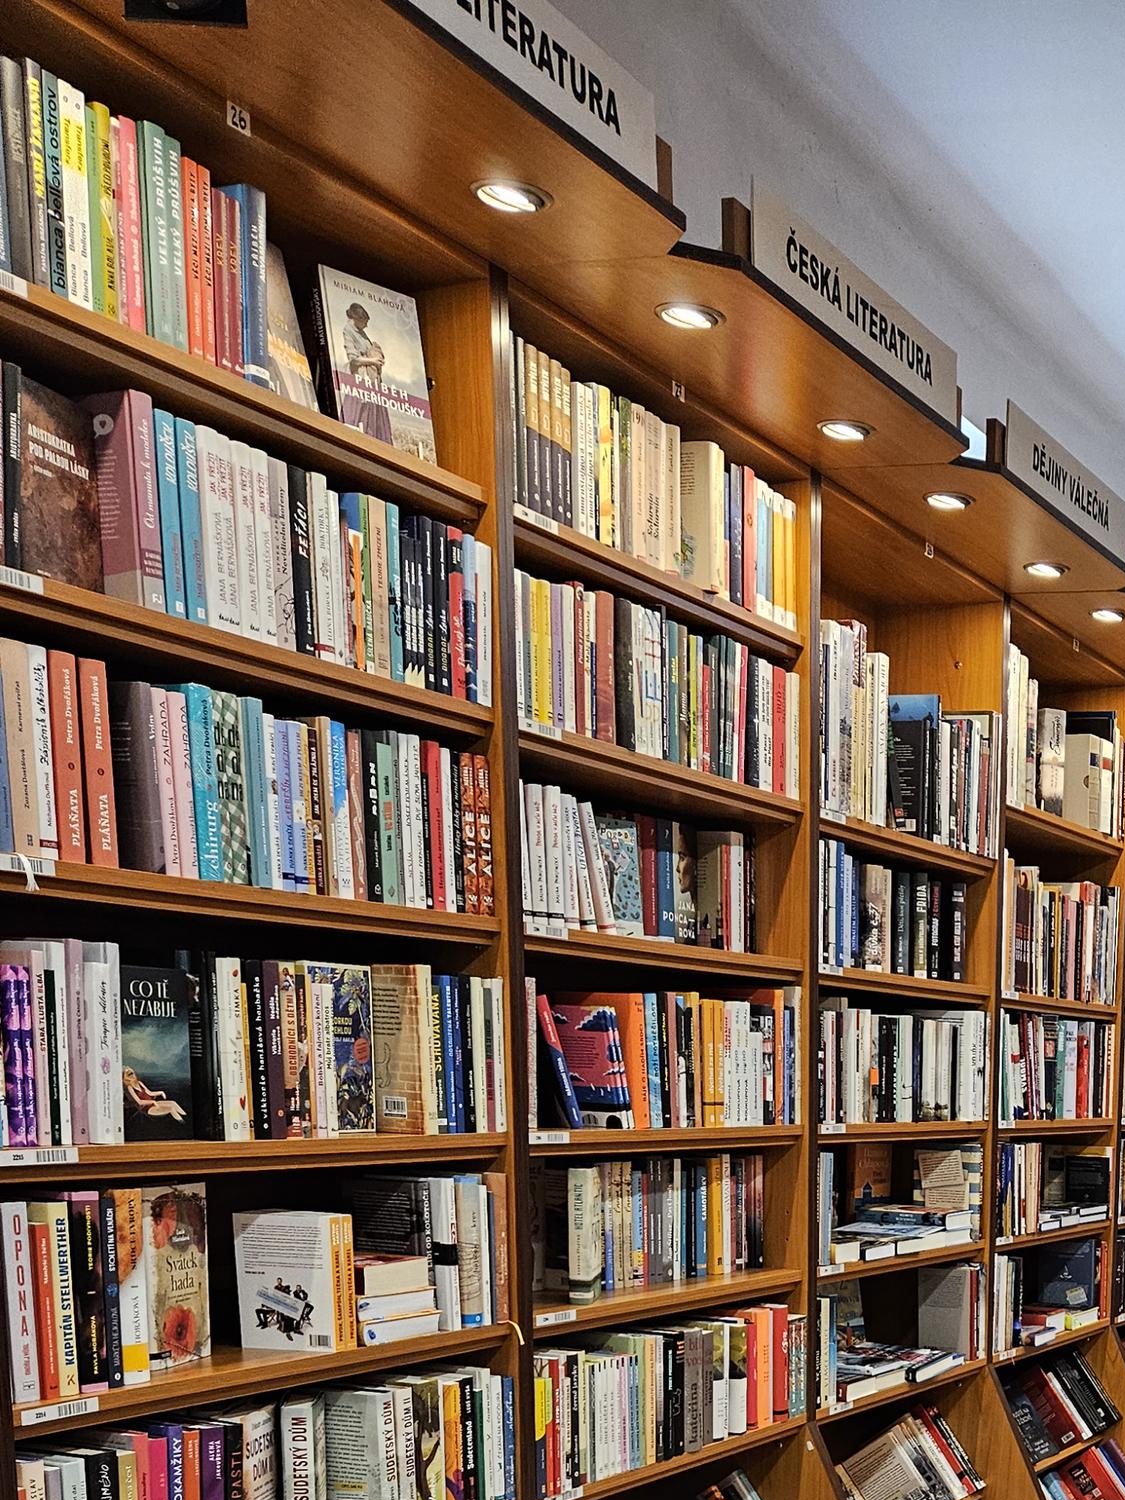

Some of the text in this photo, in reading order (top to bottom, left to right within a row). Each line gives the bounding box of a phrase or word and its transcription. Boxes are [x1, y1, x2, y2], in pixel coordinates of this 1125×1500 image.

[46, 87, 60, 150] ostrov
[230, 108, 247, 130] 26
[153, 137, 168, 265] VELKÝ PRŮŠVIH
[169, 150, 184, 276] VELKÝ PRŮŠVIH
[53, 223, 67, 291] bianca
[68, 215, 78, 296] Bianca Bellová
[82, 269, 90, 302] Bianca
[333, 280, 365, 297] MIRIAM
[786, 226, 933, 387] ČESKÁ LITERATURA
[340, 382, 425, 420] MATEŘÍDOUŠKY
[354, 373, 409, 401] PŘÍBĚH
[27, 421, 76, 458] ARISTOKRATKA
[29, 440, 90, 481] POD PALBOU LÁSKY
[1032, 443, 1110, 531] DĚJINY VÁLEČNÁ
[62, 668, 74, 745] Petra Dvořáková
[91, 675, 103, 750] Petra Dvořáková
[159, 700, 170, 766] ZAHRADA
[179, 704, 190, 768] ZAHRADA
[202, 699, 213, 775] Petra Dvořáková
[69, 789, 81, 847] PLÁŇATA
[99, 794, 112, 851] PLÁŇATA
[465, 811, 477, 876] ALICE
[480, 812, 492, 877] ALICE
[123, 1000, 177, 1018] NEZABIJE
[129, 979, 169, 999] CO TĚ
[258, 1075, 269, 1121] viktorie
[574, 1213, 583, 1231] HOTEL
[12, 1214, 30, 1337] OPONA
[56, 1217, 76, 1366] KAPITÁN STELLWERTHER
[165, 1253, 198, 1274] Svátek
[171, 1274, 195, 1291] hada
[292, 1416, 308, 1444] DŮM
[383, 1400, 397, 1482] SUDETSKÝ DŮM
[405, 1406, 415, 1478] SUDETSKÝ DŮM
